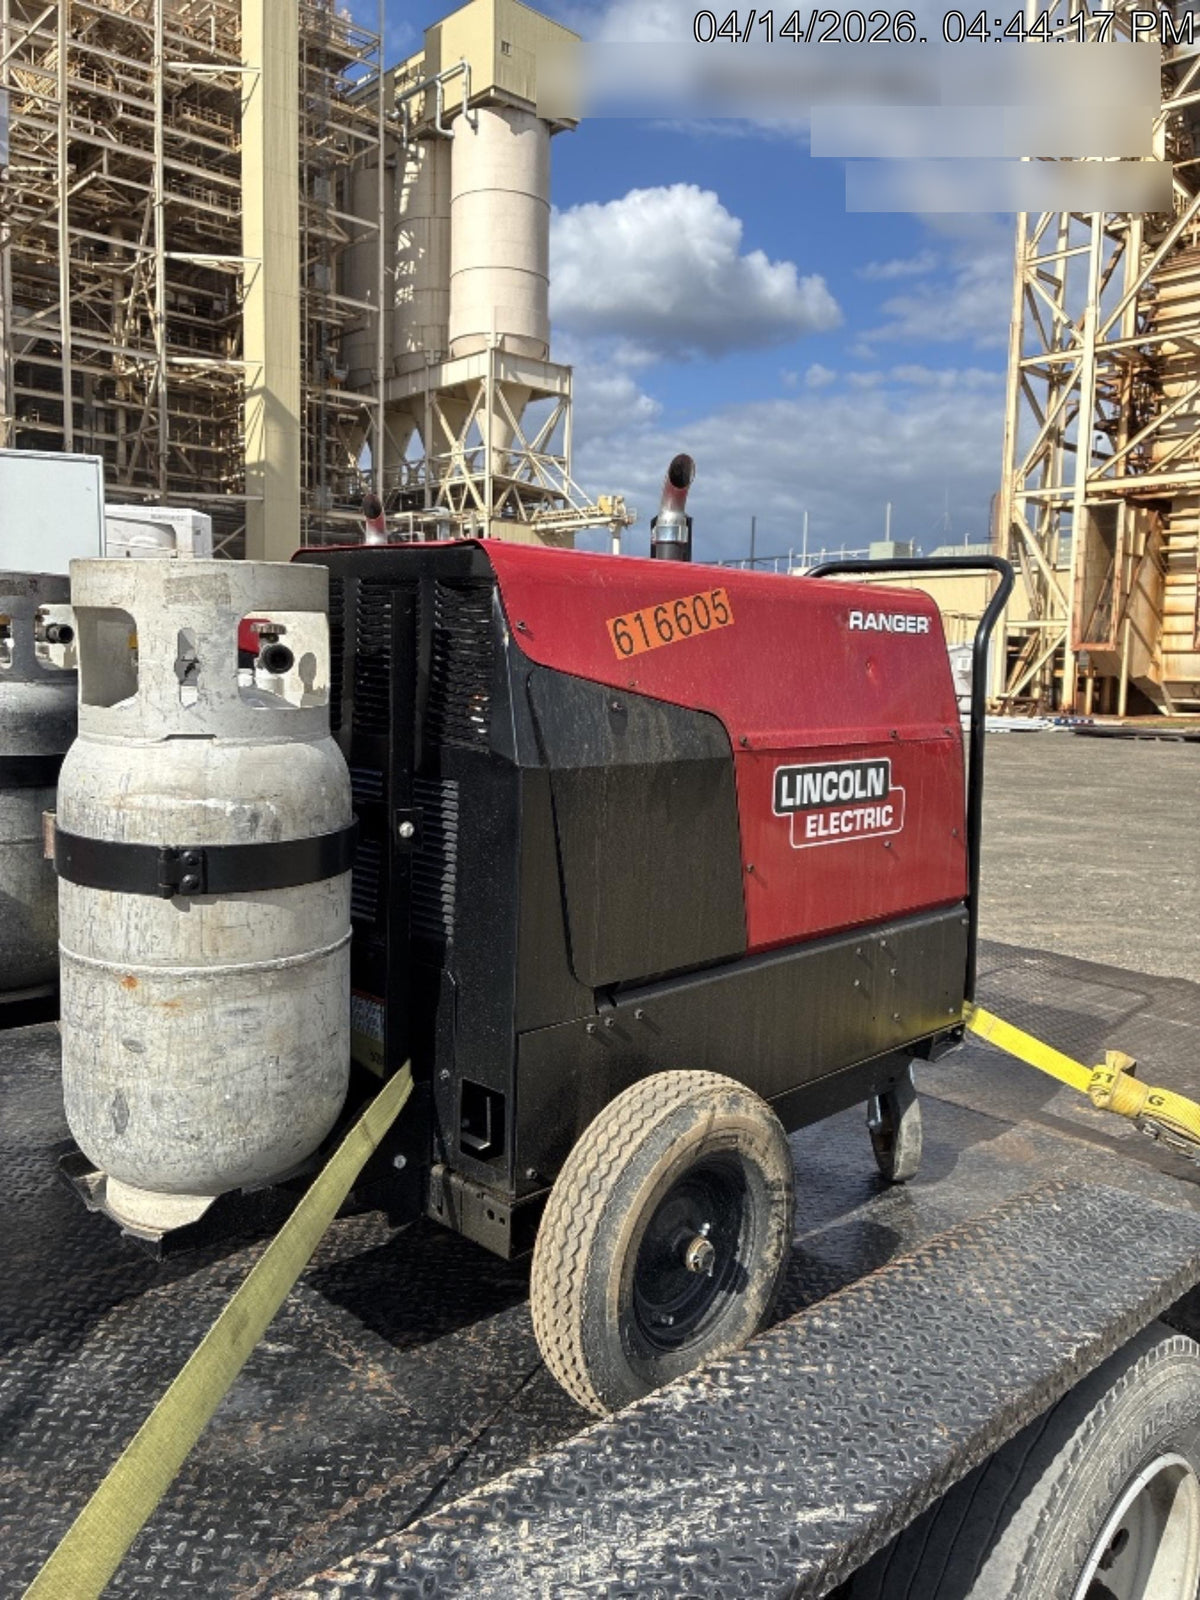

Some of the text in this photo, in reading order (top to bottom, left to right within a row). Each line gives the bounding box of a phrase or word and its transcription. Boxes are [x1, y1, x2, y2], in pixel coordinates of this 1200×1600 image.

[612, 590, 729, 655] 616605
[849, 610, 930, 634] RANGER
[781, 767, 885, 807] LINCOLN
[805, 805, 893, 838] ELECTRIC
